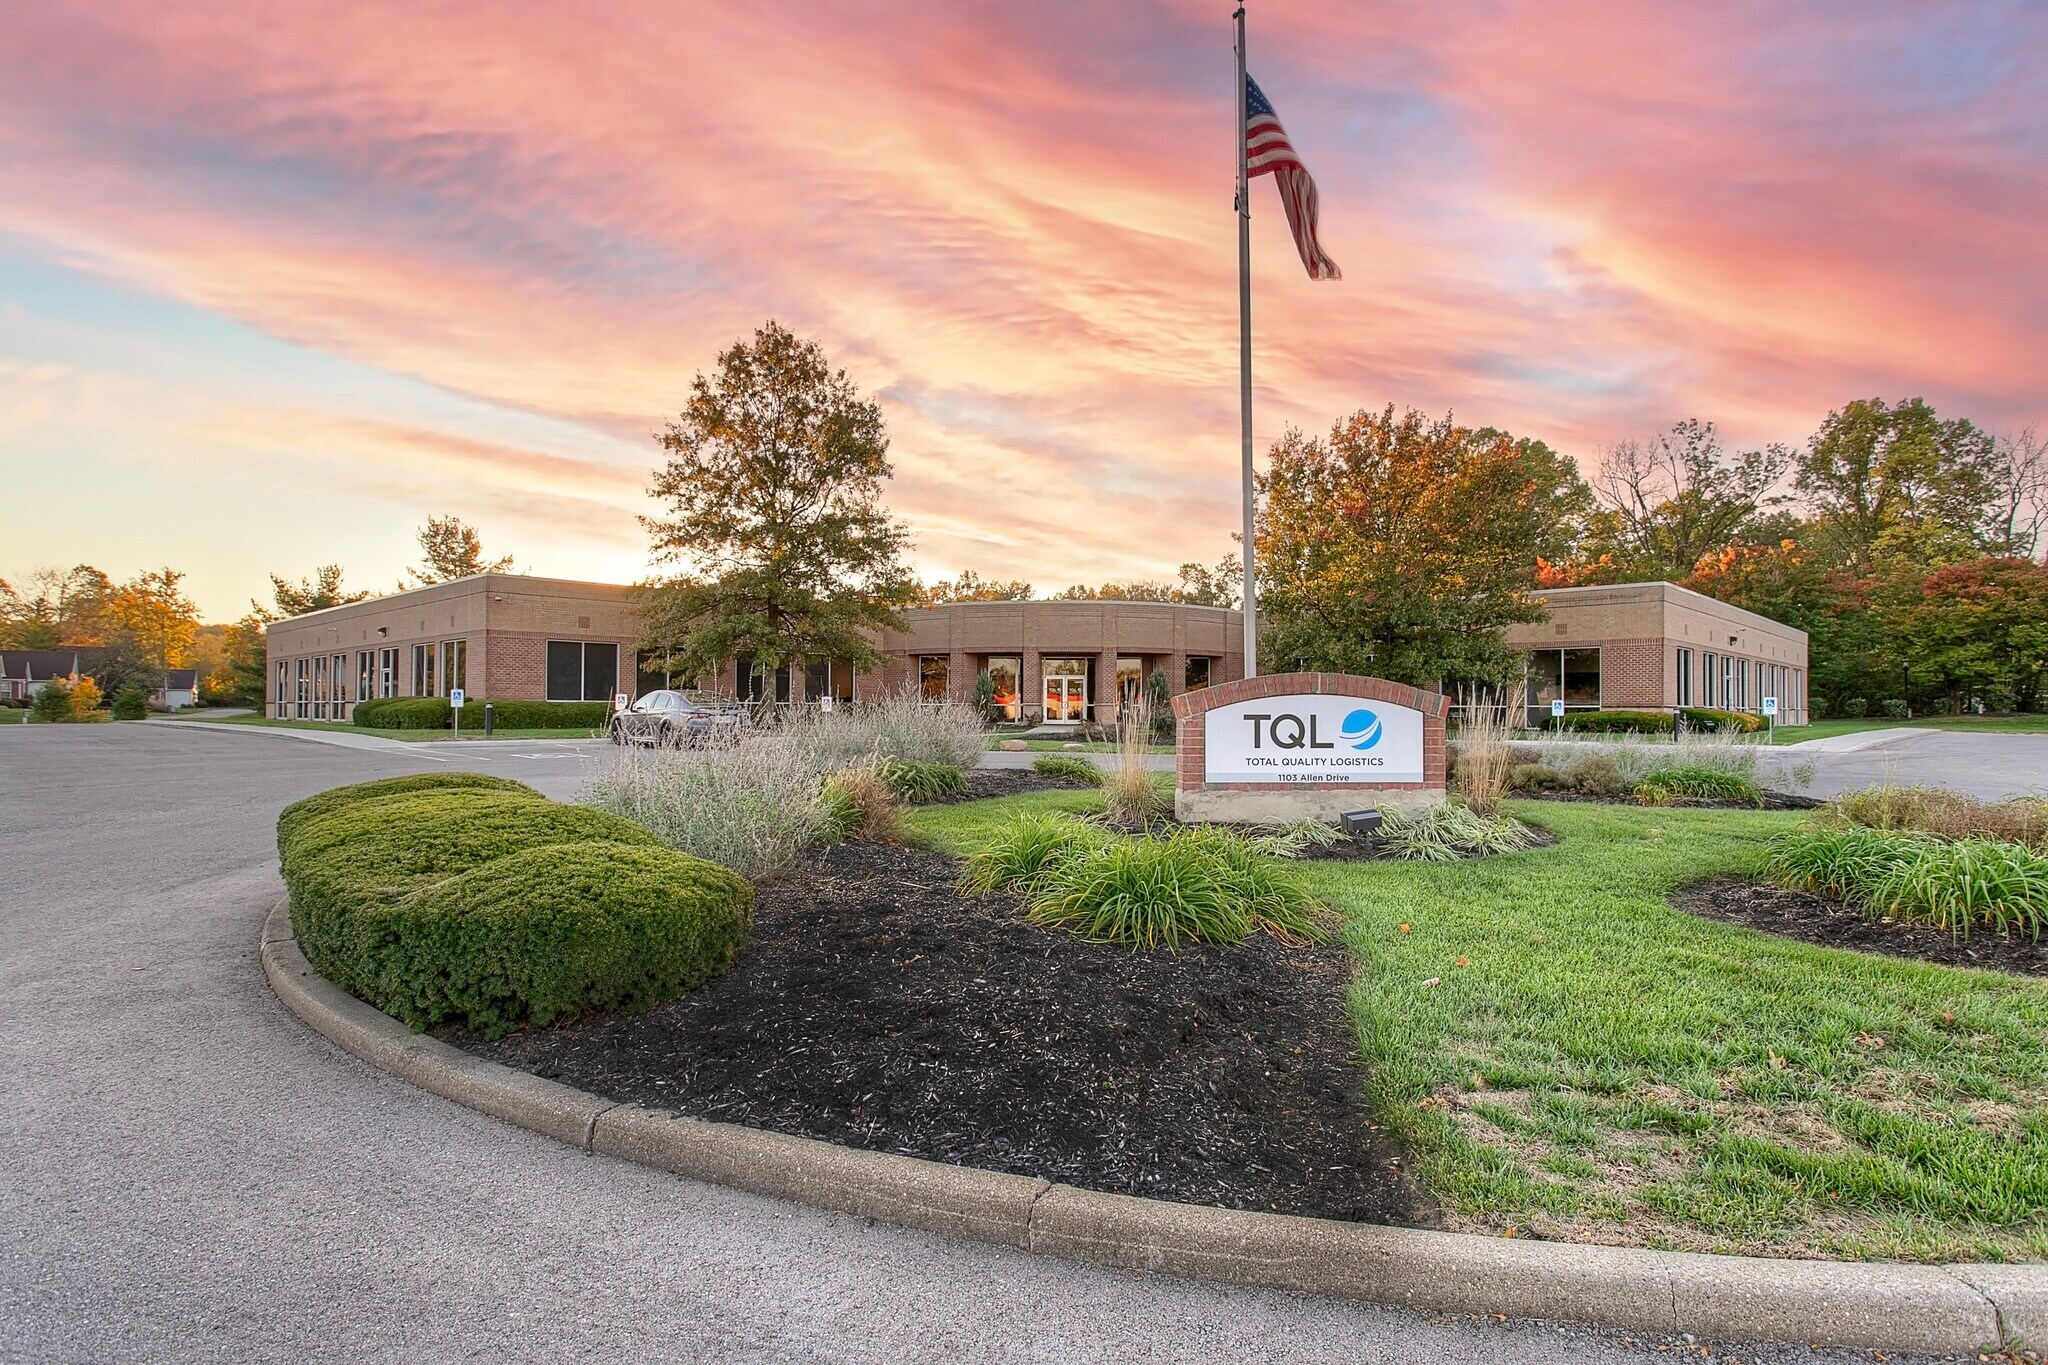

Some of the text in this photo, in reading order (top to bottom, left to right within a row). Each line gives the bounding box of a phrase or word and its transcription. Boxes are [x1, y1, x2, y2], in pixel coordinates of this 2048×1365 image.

[1243, 713, 1335, 750] TQL
[1245, 757, 1384, 767] TOTAL QUALITY LOGISTICS
[1278, 773, 1350, 782] 1103 Allen Drive
